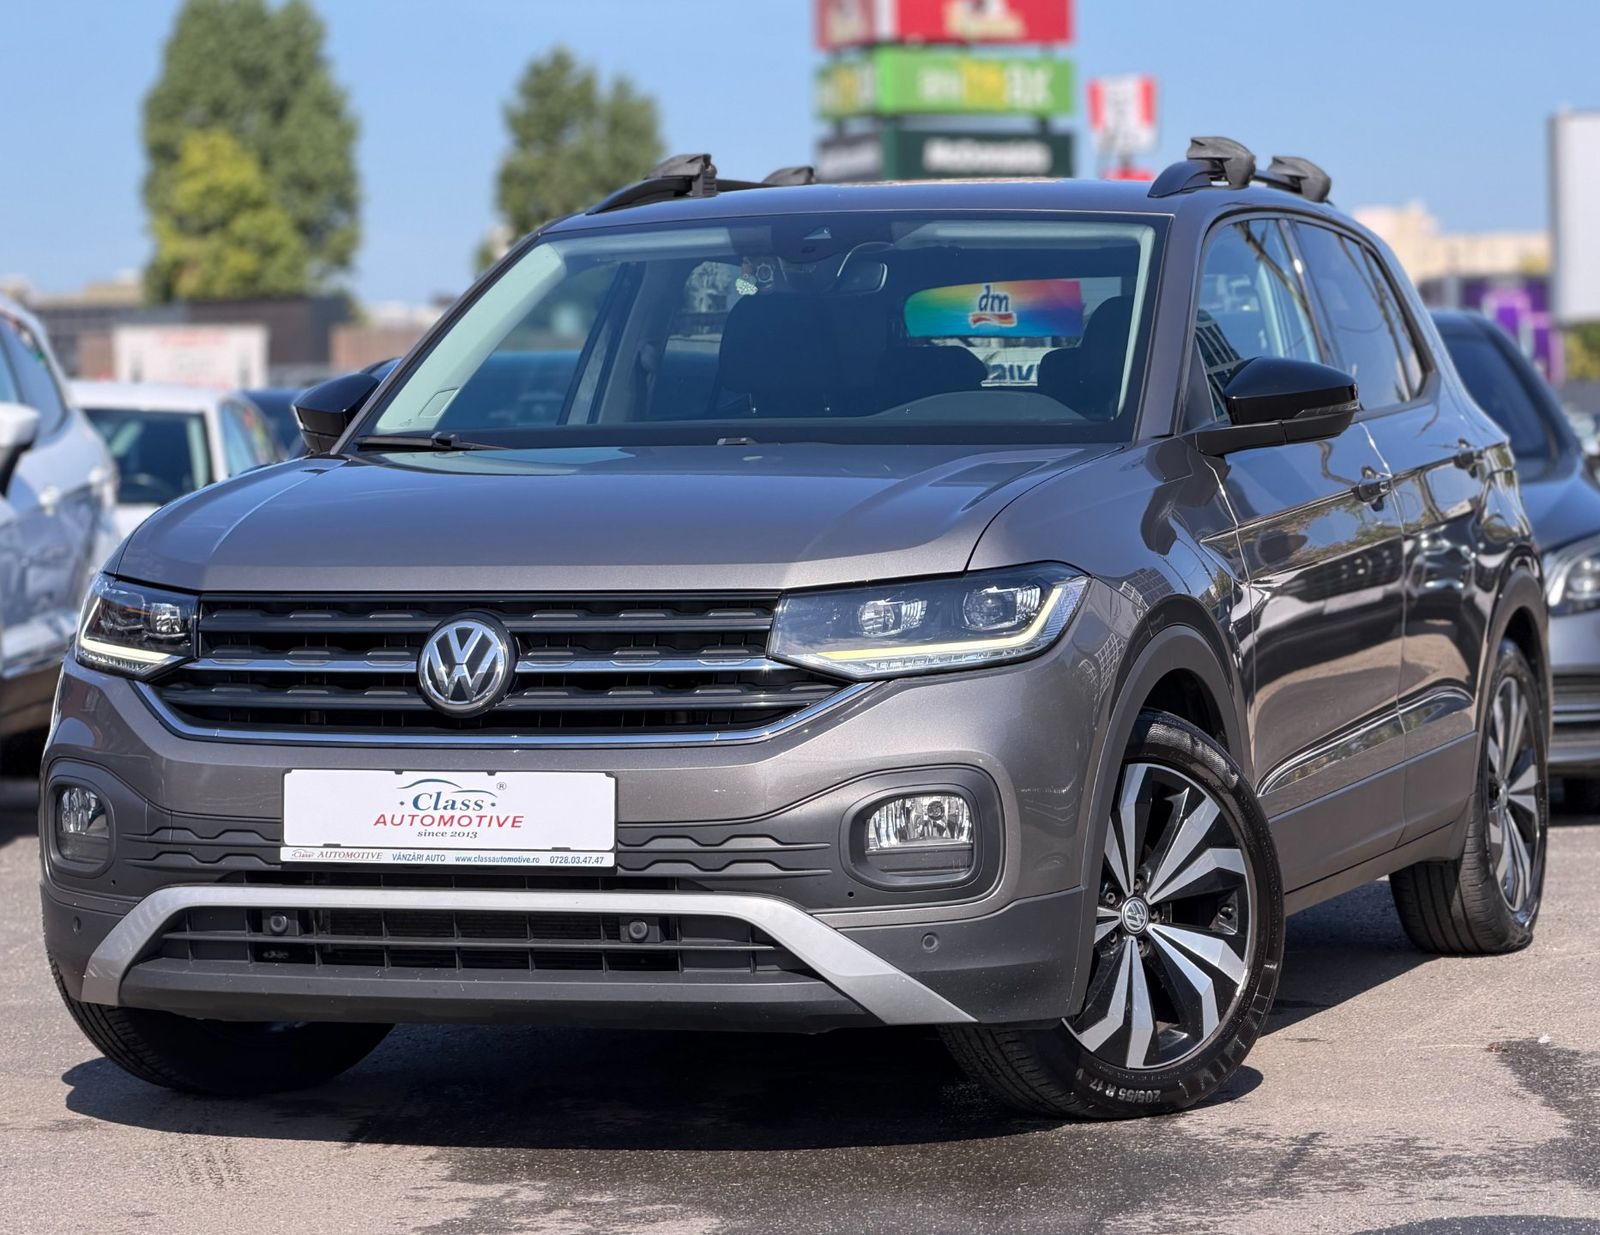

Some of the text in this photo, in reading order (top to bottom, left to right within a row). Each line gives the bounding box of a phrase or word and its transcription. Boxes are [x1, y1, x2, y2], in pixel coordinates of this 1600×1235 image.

[979, 284, 1009, 312] dm
[425, 624, 503, 705] VW
[412, 791, 484, 811] Class
[373, 814, 525, 829] AUTOMOTIVE
[417, 829, 479, 839] since 2013
[317, 851, 384, 860] AUTOMOTIVE
[425, 854, 447, 862] AUTO
[455, 854, 541, 864] www.classautomotive.ro
[549, 855, 605, 865] 0728.03.47.47
[1117, 1087, 1161, 1103] 205/55
